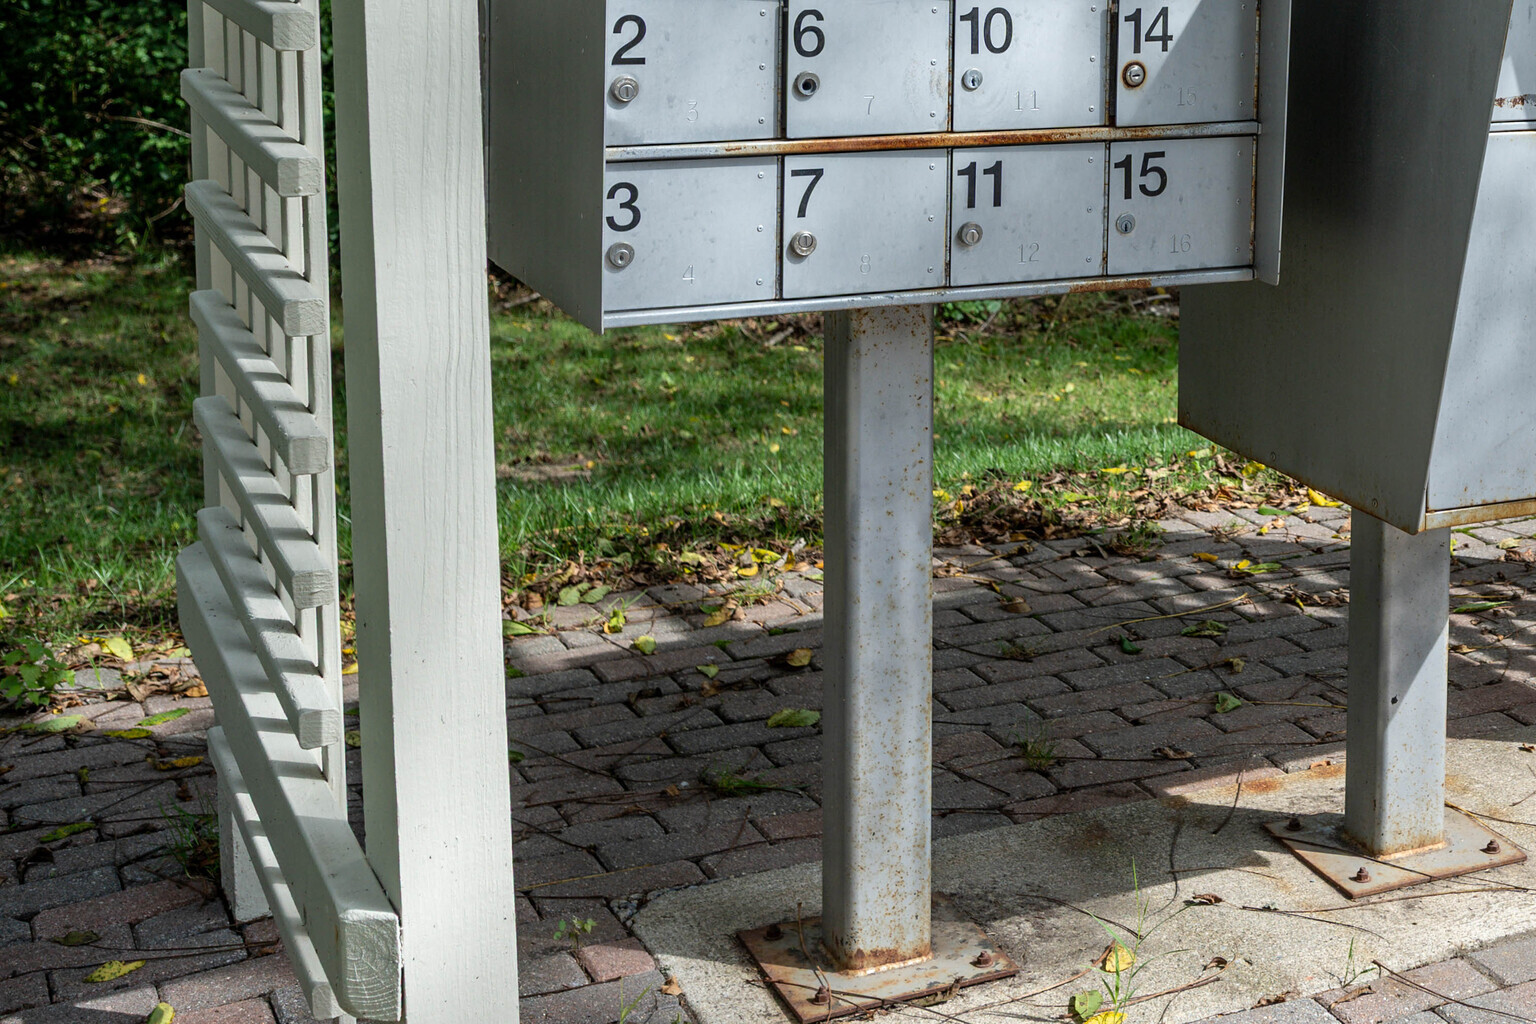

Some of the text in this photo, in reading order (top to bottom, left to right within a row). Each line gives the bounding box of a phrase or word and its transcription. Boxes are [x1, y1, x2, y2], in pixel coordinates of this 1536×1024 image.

[611, 14, 647, 66] 2
[793, 9, 826, 58] 6
[959, 6, 1013, 55] 10
[1123, 6, 1174, 54] 14
[686, 100, 699, 123] 3
[863, 94, 875, 115] 7
[1013, 89, 1040, 112] 11
[1176, 86, 1197, 107] 15
[957, 160, 1003, 209] 11
[1113, 150, 1168, 200] 15
[605, 181, 642, 233] 3
[790, 167, 825, 219] 7
[1017, 242, 1040, 265] 12
[1169, 233, 1192, 255] 16
[682, 264, 695, 285] 4
[859, 254, 871, 275] 8
